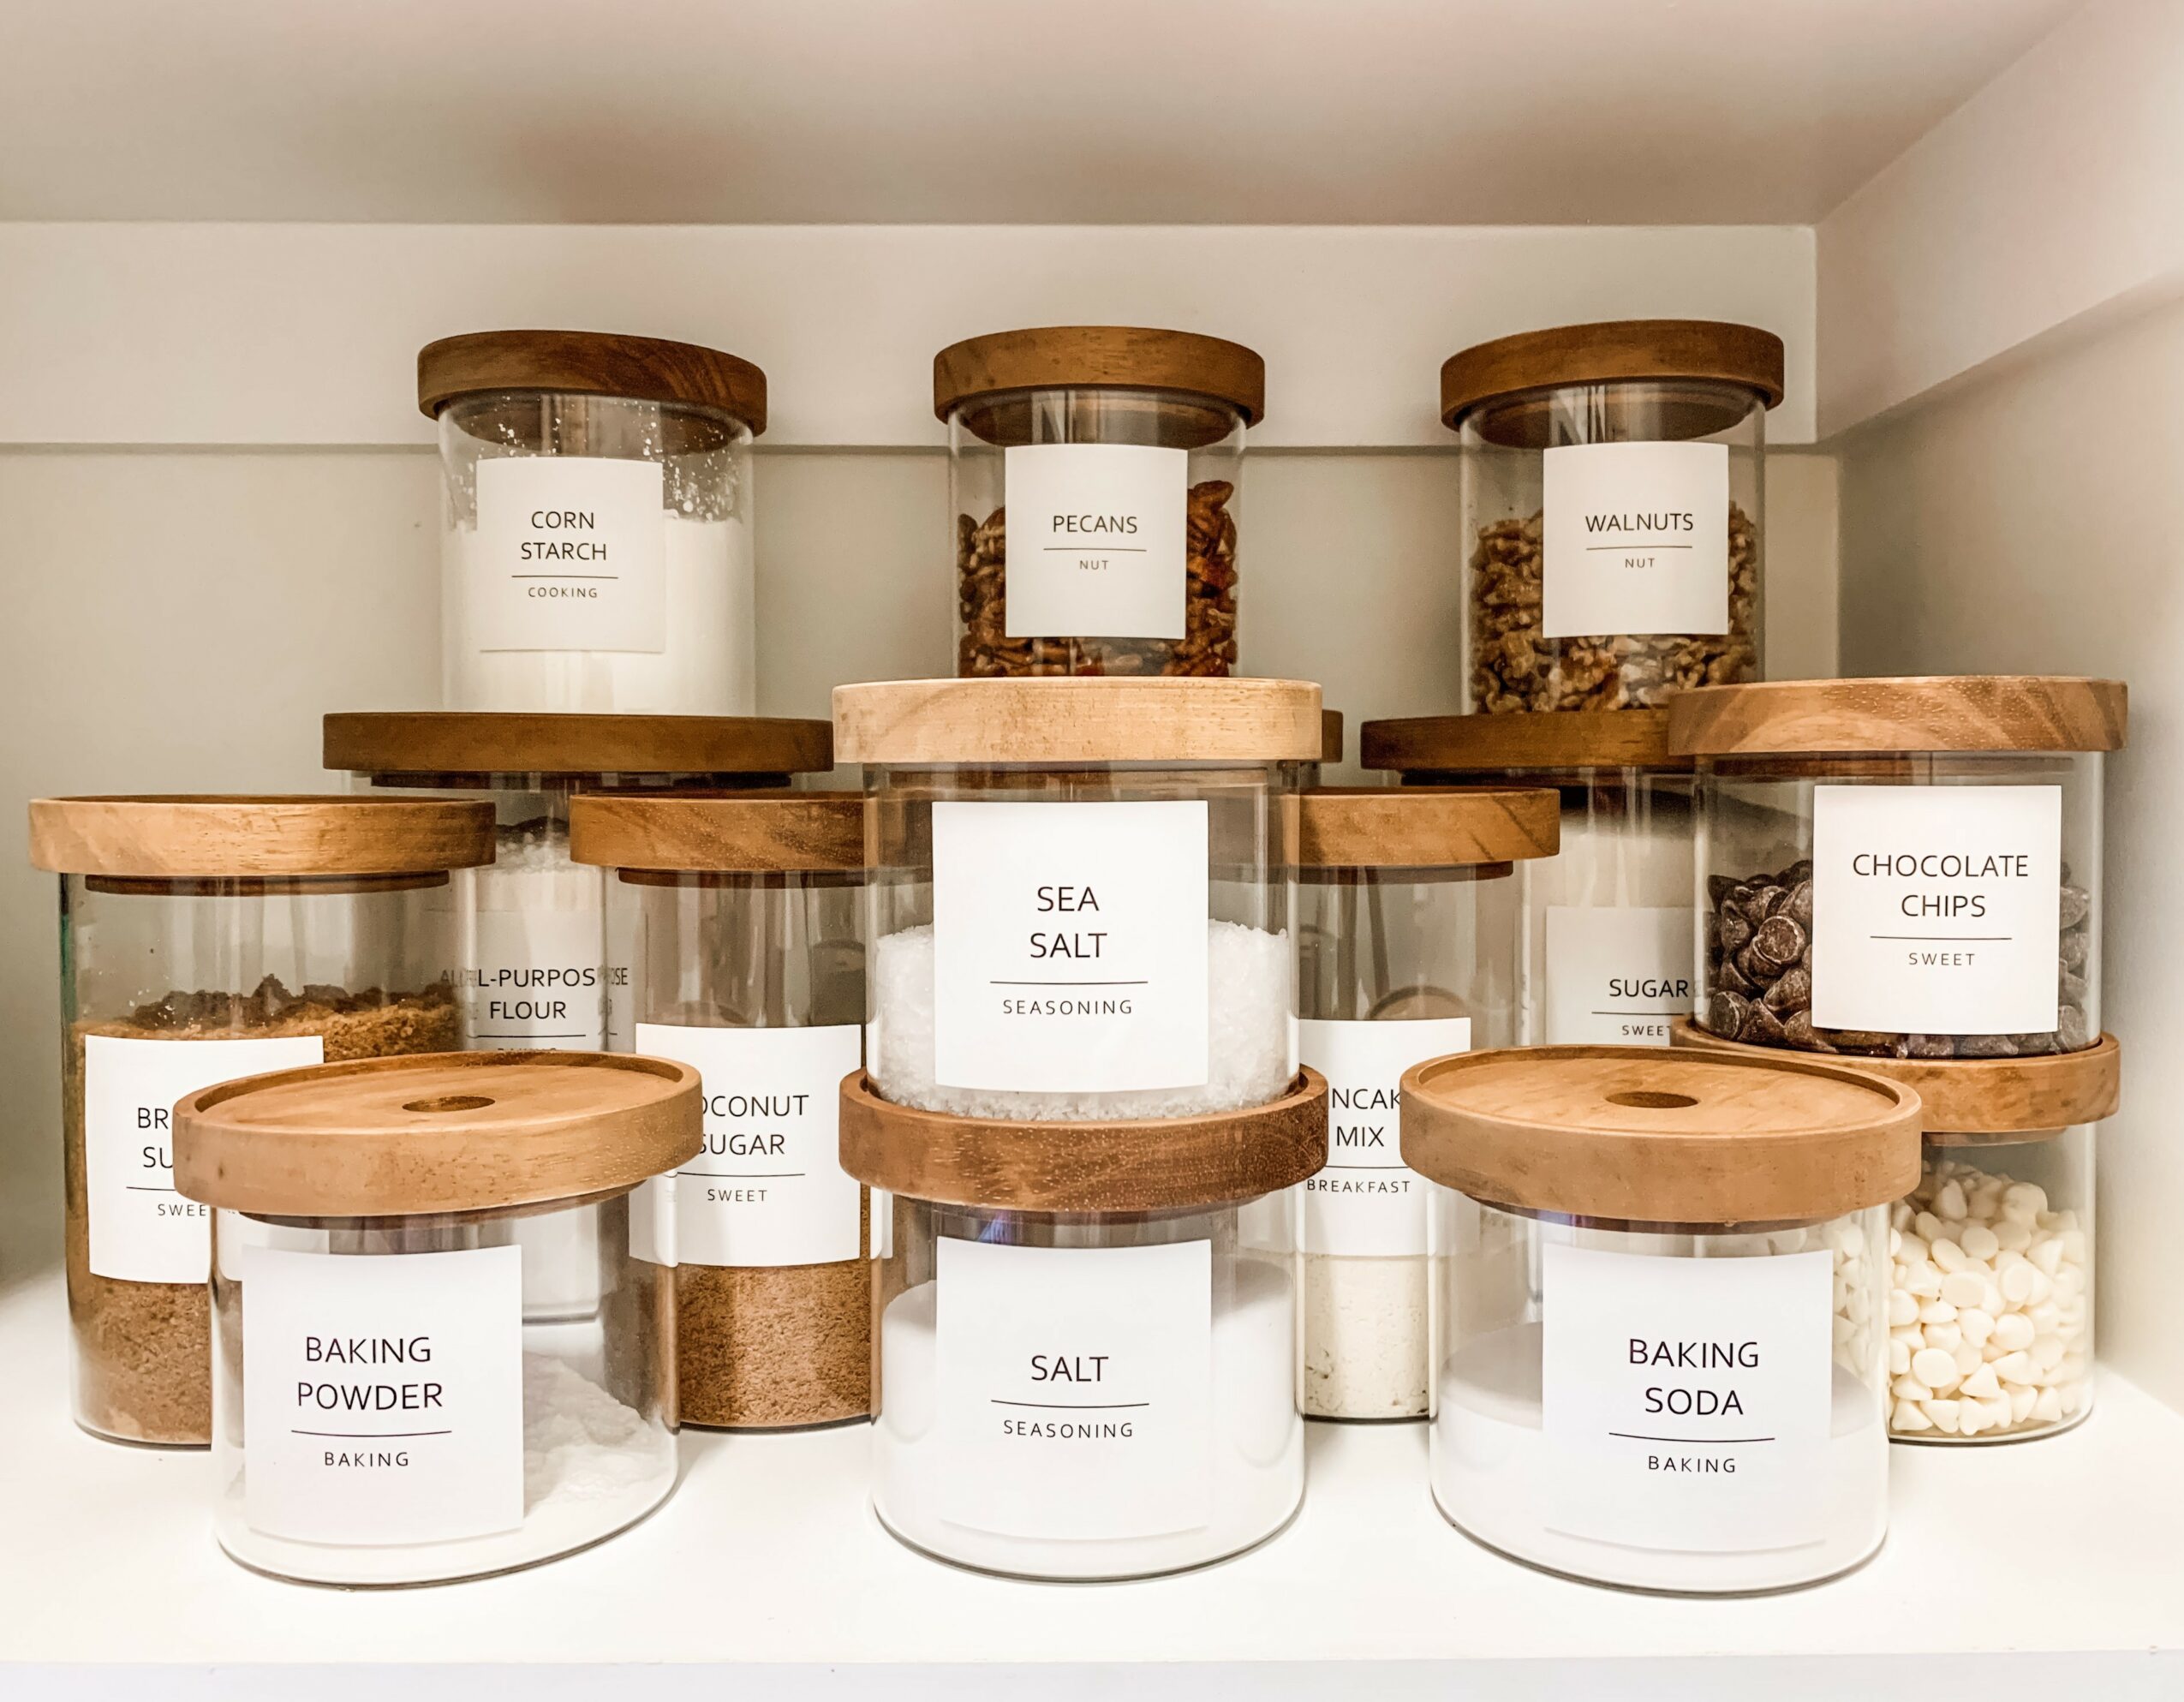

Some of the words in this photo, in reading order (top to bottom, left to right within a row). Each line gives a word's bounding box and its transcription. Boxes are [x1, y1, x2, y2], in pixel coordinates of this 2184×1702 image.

[531, 511, 594, 529] CORN
[1053, 515, 1137, 534] PECANS
[1584, 512, 1694, 533] WALNUTS
[521, 541, 606, 561] STARCH
[1079, 559, 1109, 570] NUT
[1625, 558, 1656, 569] NUT
[528, 587, 598, 599] COOKING
[1853, 853, 2029, 878] CHOCOLATE
[1037, 886, 1100, 912] SEA
[1901, 894, 1985, 917] CHIPS
[1029, 932, 1108, 958] SALT
[1908, 952, 1975, 966] SWEET
[1608, 978, 1690, 999] SUGAR
[490, 1000, 566, 1020] FLOUR
[1003, 999, 1131, 1015] SEASONING
[1335, 1126, 1385, 1148] MIX
[707, 1188, 767, 1202] SWEET
[1306, 1178, 1411, 1194] BREAKFAST
[157, 1203, 207, 1217] SWEE
[306, 1336, 431, 1364] BAKING
[1629, 1338, 1758, 1369] BAKING
[1030, 1354, 1110, 1383] SALT
[298, 1382, 443, 1411] POWDER
[1645, 1387, 1744, 1416] SODA
[1004, 1419, 1132, 1439] SEASONING
[325, 1451, 409, 1467] BAKING
[1648, 1455, 1735, 1473] BAKING
